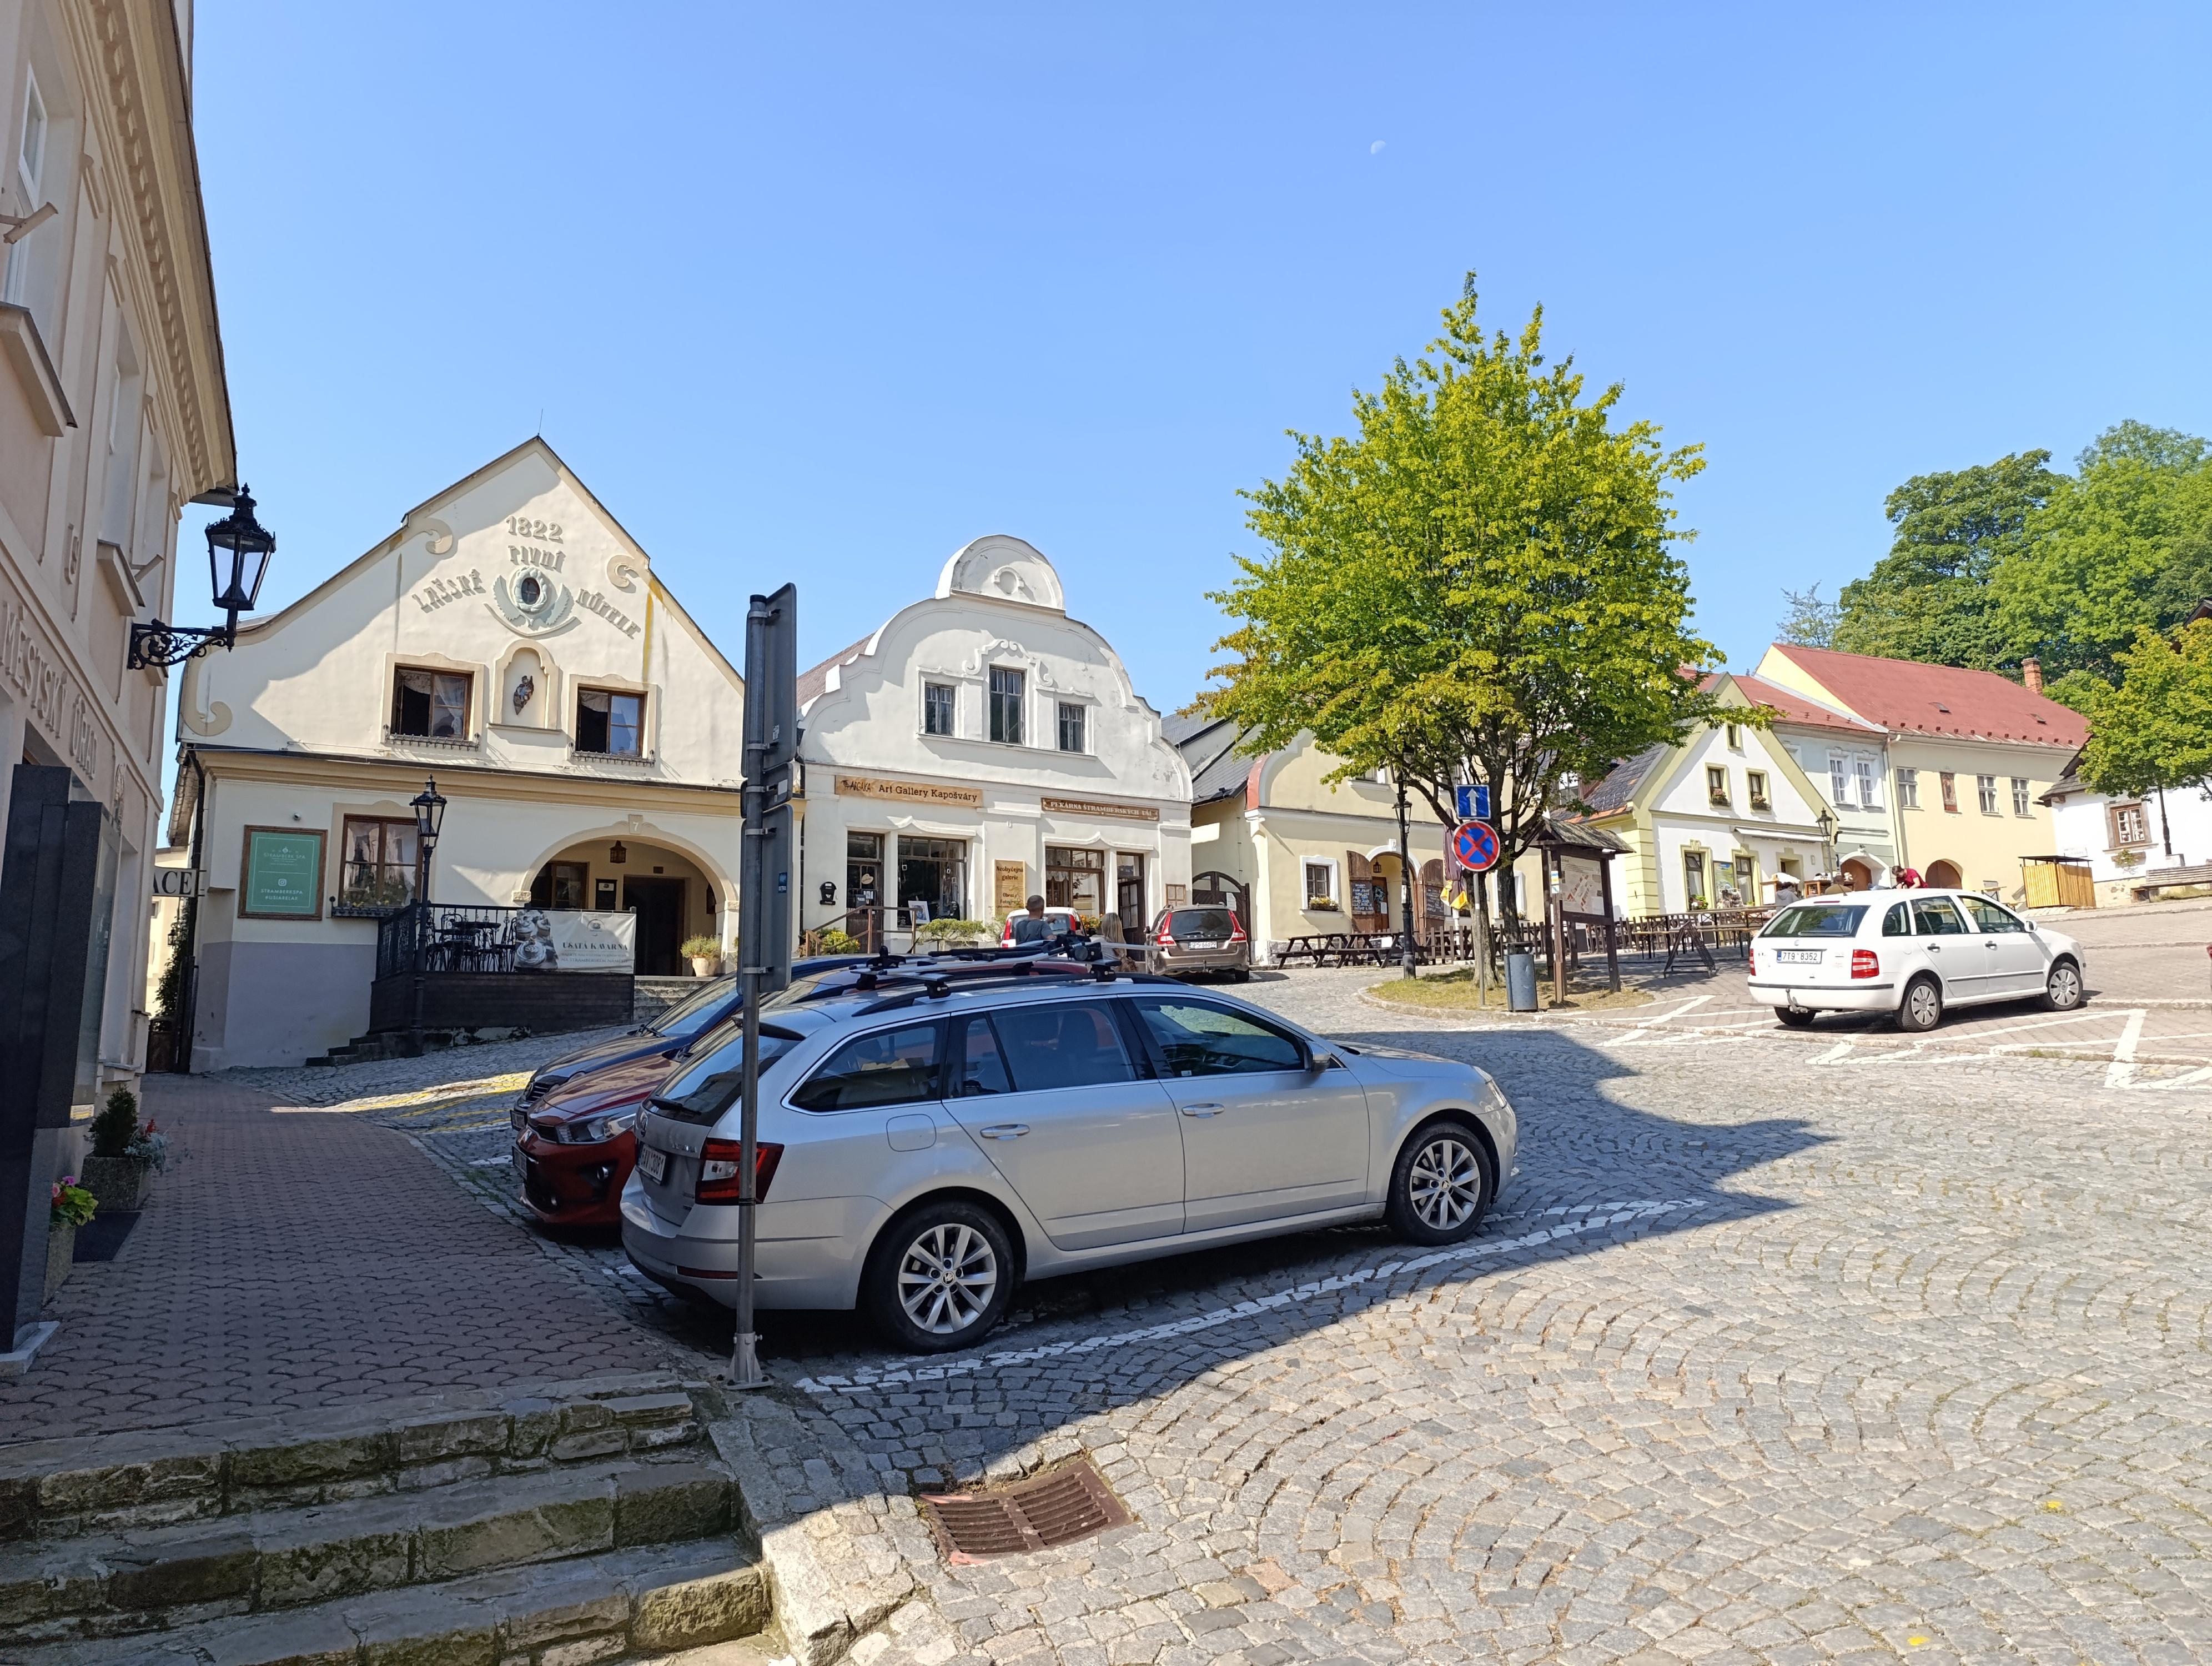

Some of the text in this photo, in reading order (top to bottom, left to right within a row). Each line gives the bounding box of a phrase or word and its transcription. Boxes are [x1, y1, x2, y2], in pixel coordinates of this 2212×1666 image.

[506, 516, 562, 543] 1822
[878, 784, 893, 793] Art
[895, 786, 928, 797] Gallery
[931, 789, 978, 802] Kapošváry
[1050, 801, 1082, 810] PEKÁRNA
[633, 821, 639, 831] 7
